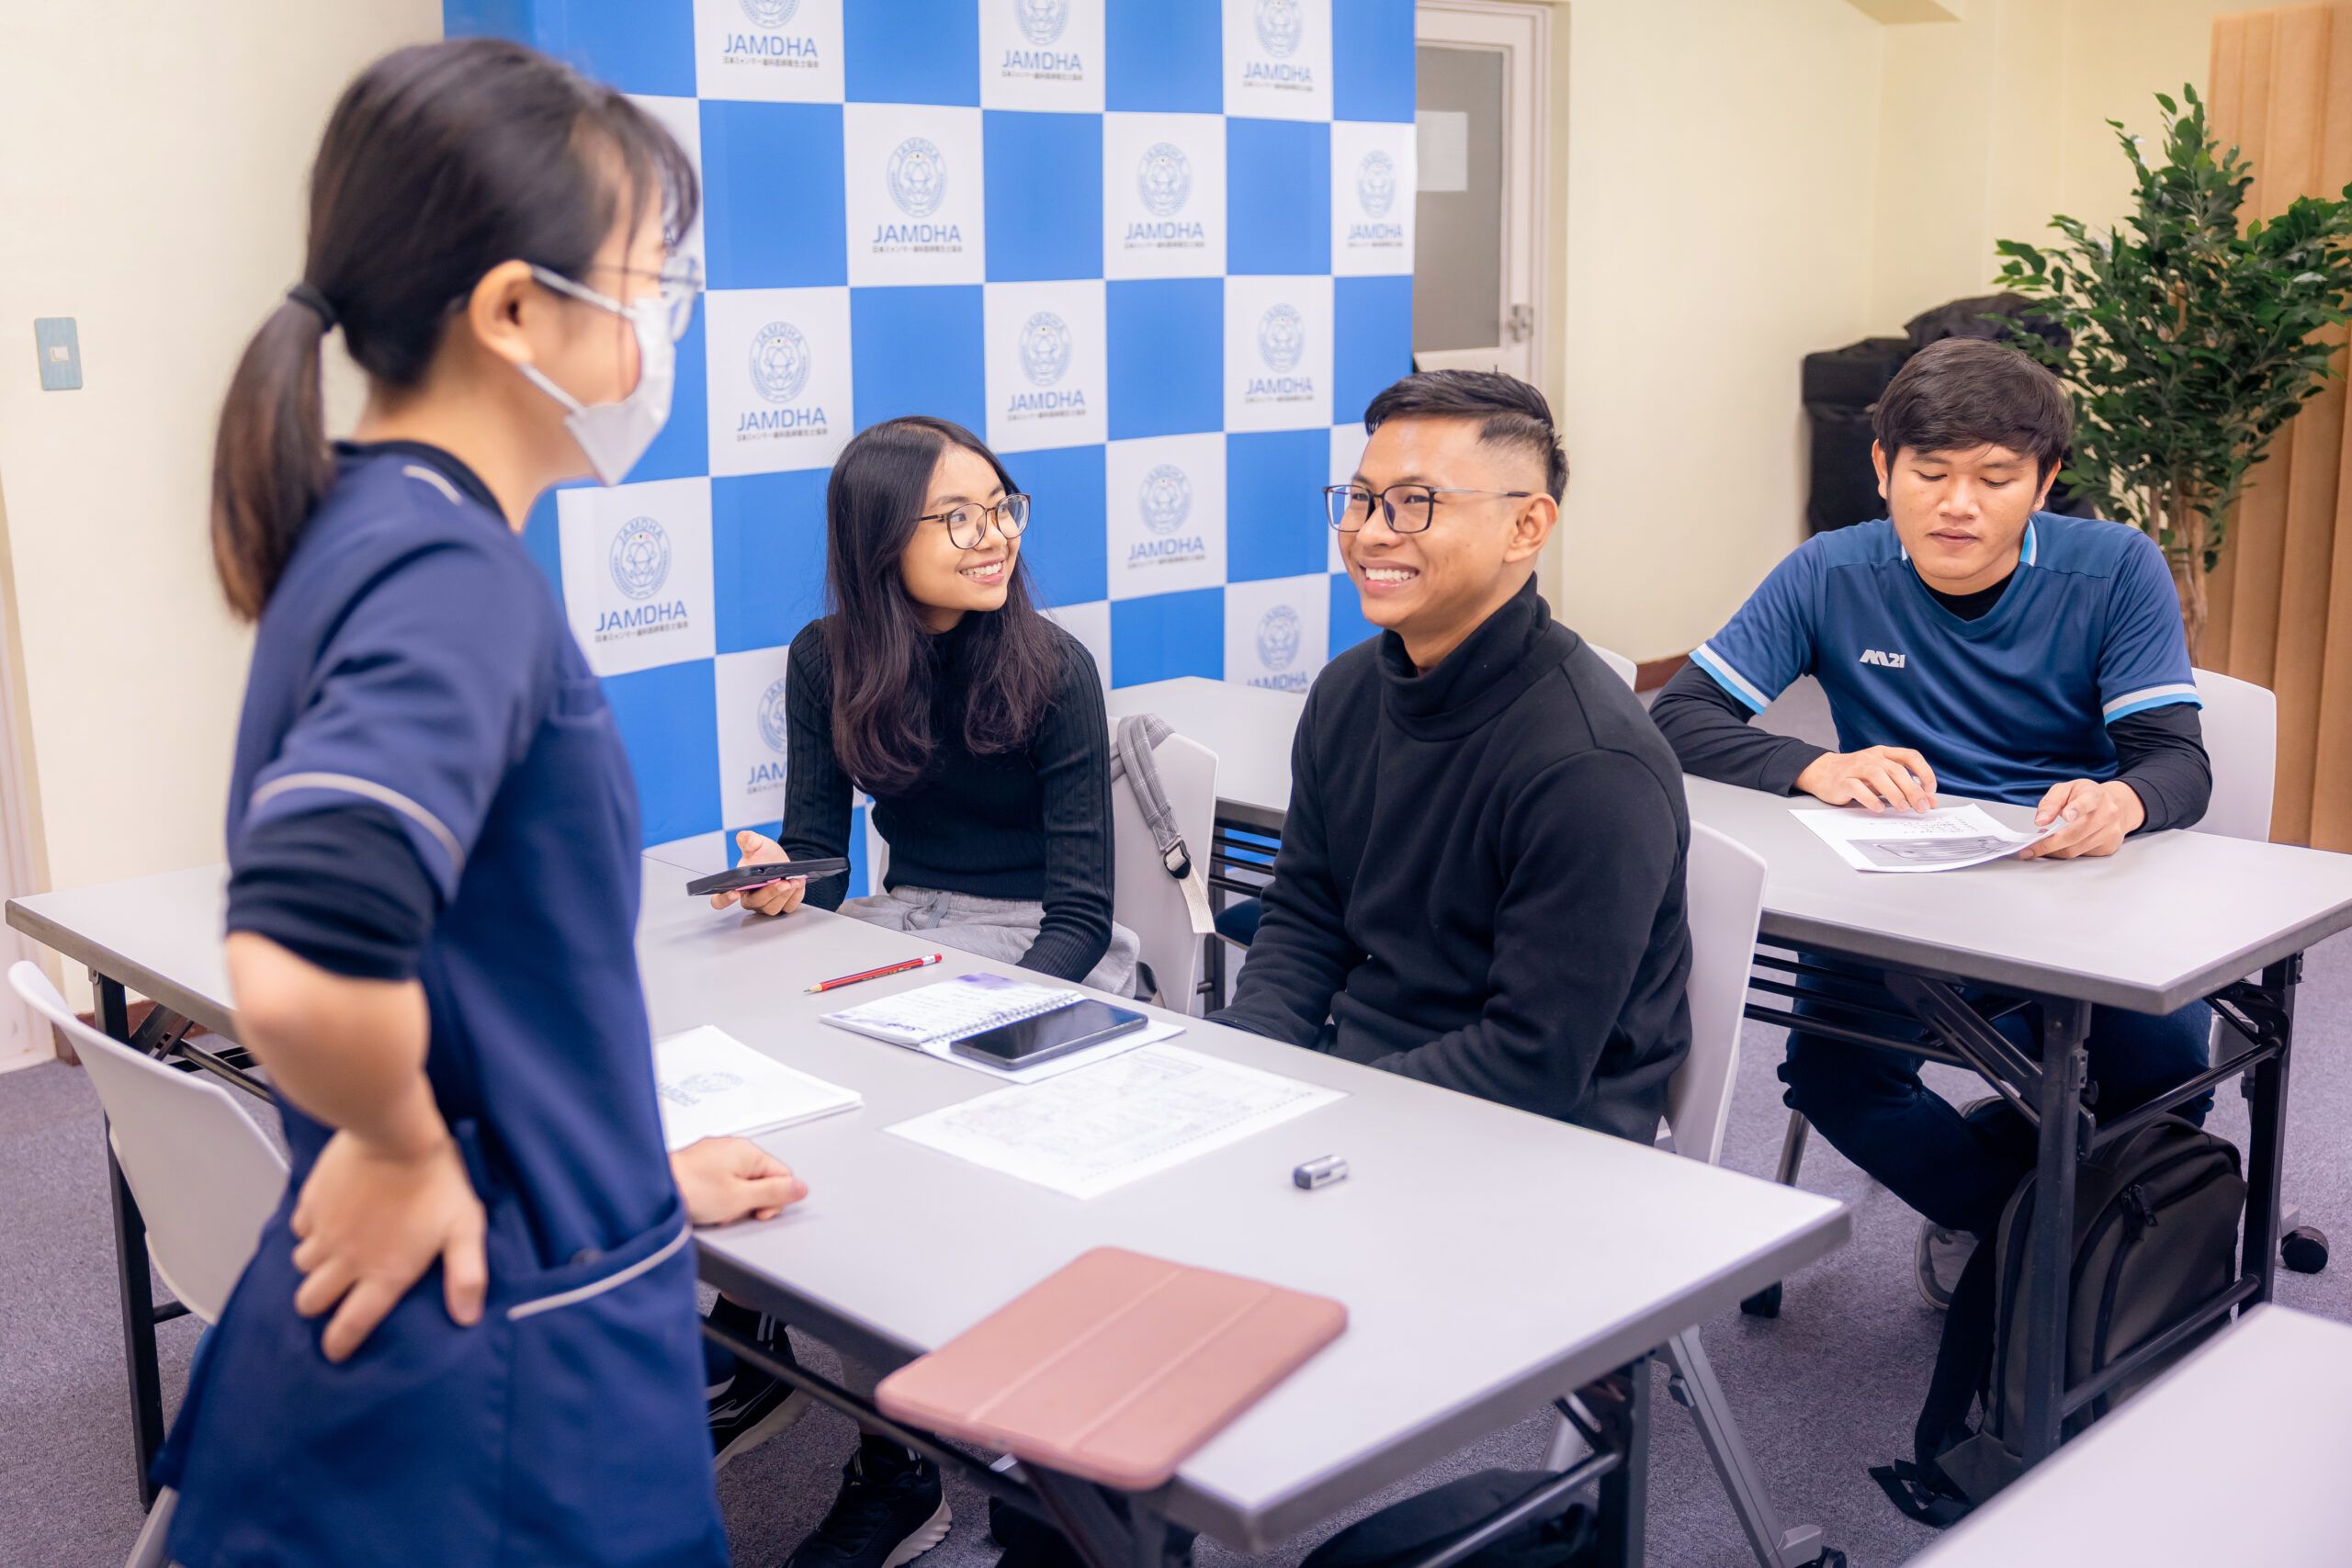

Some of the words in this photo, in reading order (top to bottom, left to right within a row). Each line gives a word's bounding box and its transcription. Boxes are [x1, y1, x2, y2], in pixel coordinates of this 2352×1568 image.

[724, 34, 818, 57] JAMDHA
[1002, 51, 1081, 71] JAMDHA
[1244, 62, 1312, 83] JAMDHA
[873, 224, 961, 243] JAMDHA
[1125, 222, 1204, 242] JAMDHA
[1348, 223, 1404, 240] JAMDHA
[1246, 377, 1313, 396] JAMDHA
[1008, 389, 1085, 412] JAMDHA
[738, 407, 827, 432] JAMDHA
[1127, 536, 1205, 561] JAMDHA
[595, 600, 687, 632] JAMDHA
[1859, 649, 1905, 669] M21
[747, 761, 787, 785] JAM
